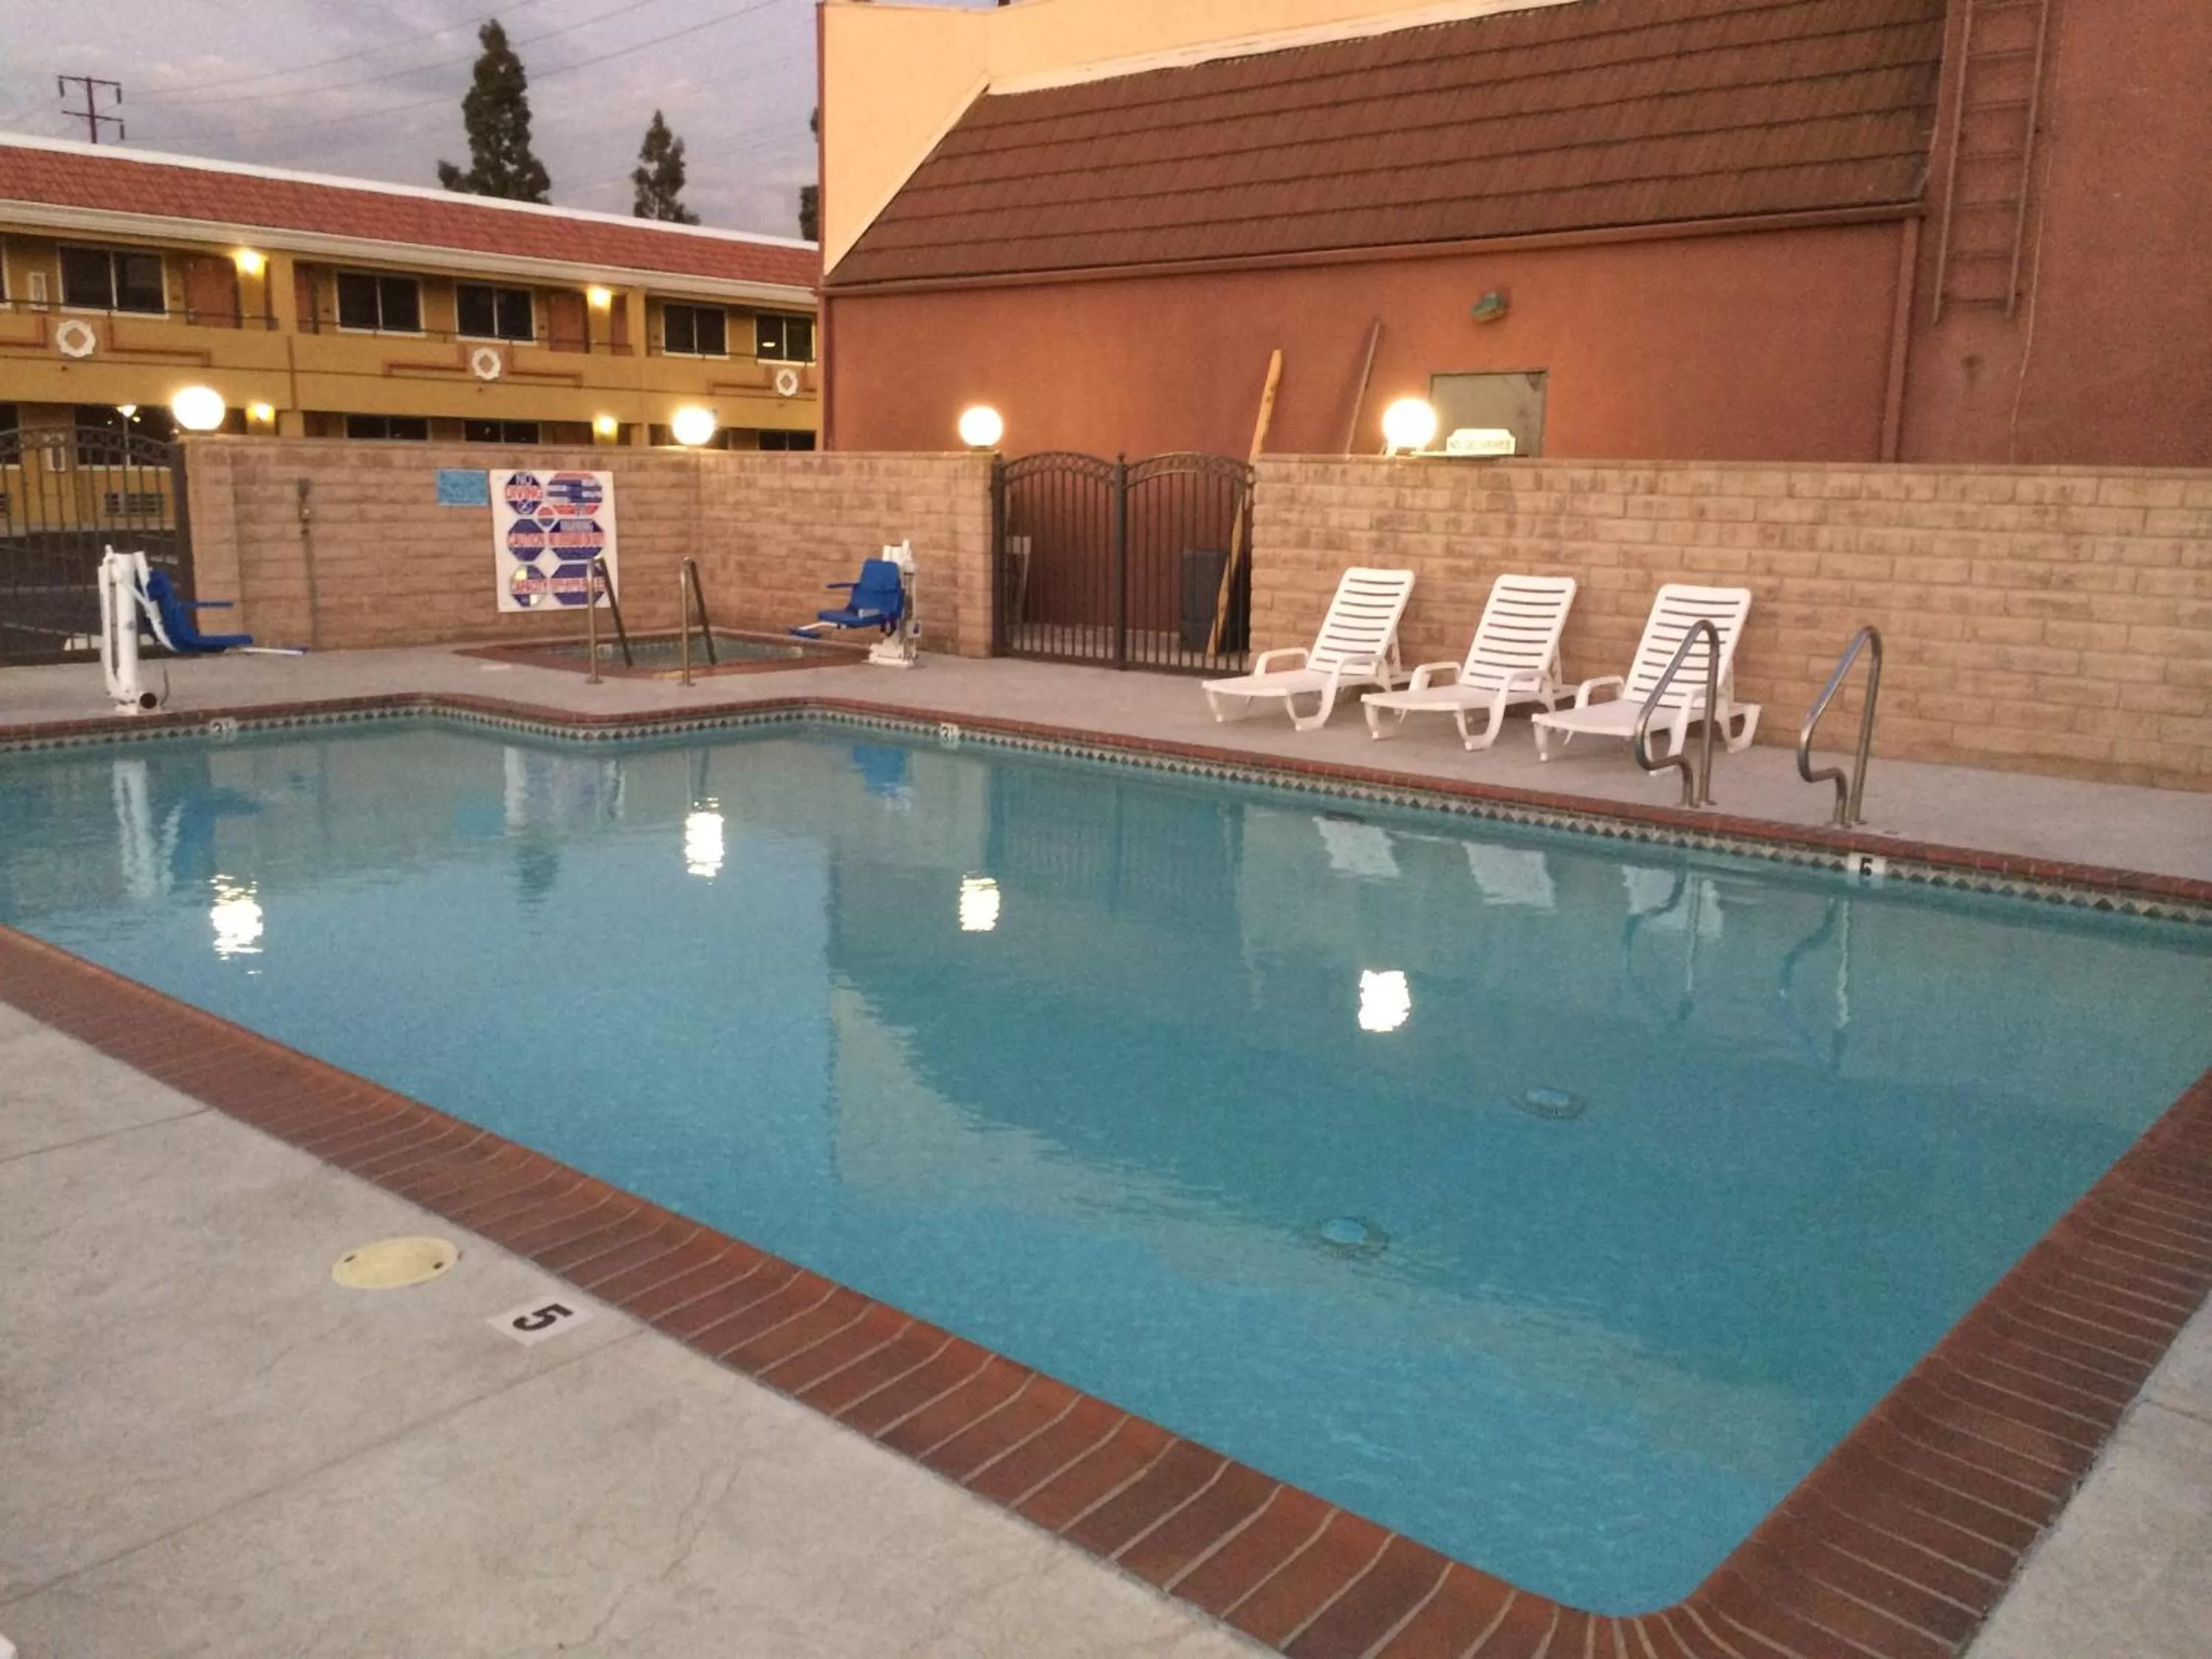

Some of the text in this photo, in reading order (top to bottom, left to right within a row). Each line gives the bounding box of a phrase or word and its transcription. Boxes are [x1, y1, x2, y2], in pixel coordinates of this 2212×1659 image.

[516, 473, 532, 485] NO
[507, 485, 543, 500] DIVING
[512, 1303, 574, 1332] 5
